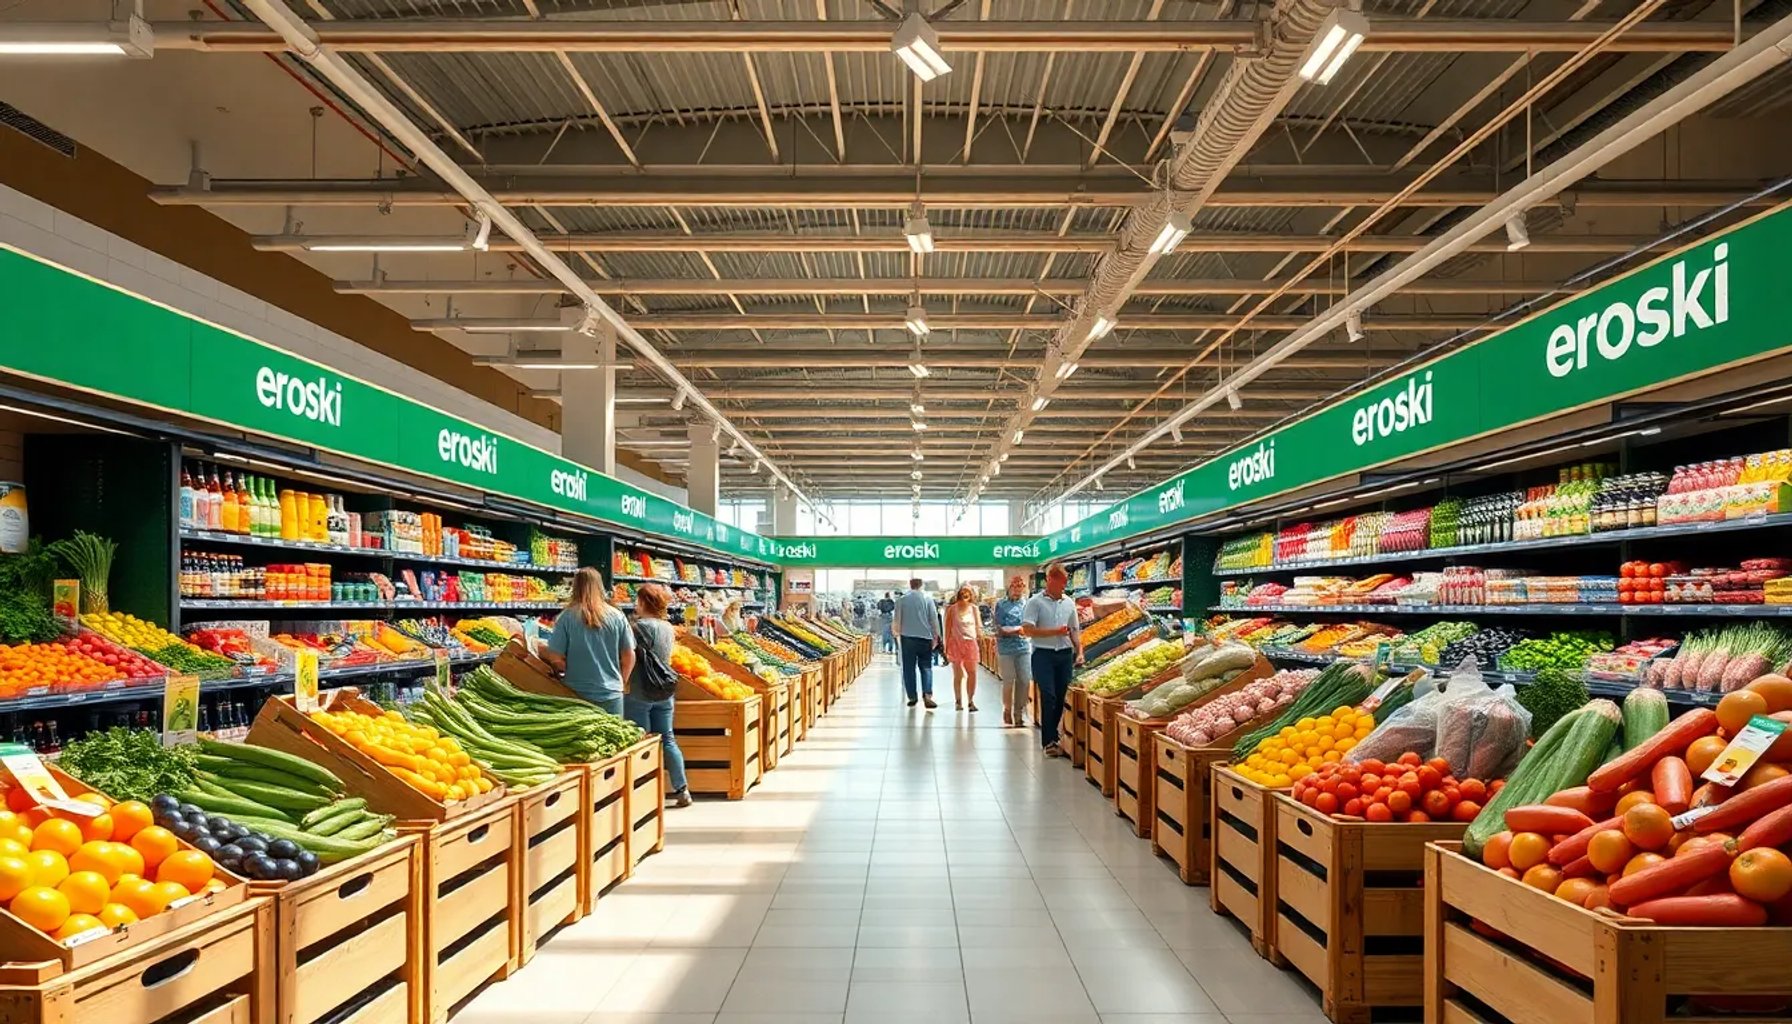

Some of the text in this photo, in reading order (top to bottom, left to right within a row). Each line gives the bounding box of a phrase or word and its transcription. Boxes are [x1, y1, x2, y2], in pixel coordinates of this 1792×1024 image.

[1547, 243, 1729, 376] eroski
[256, 366, 342, 427] eroski
[1353, 371, 1433, 445] eroski
[438, 429, 497, 474] eroski
[1229, 440, 1275, 490] eroski
